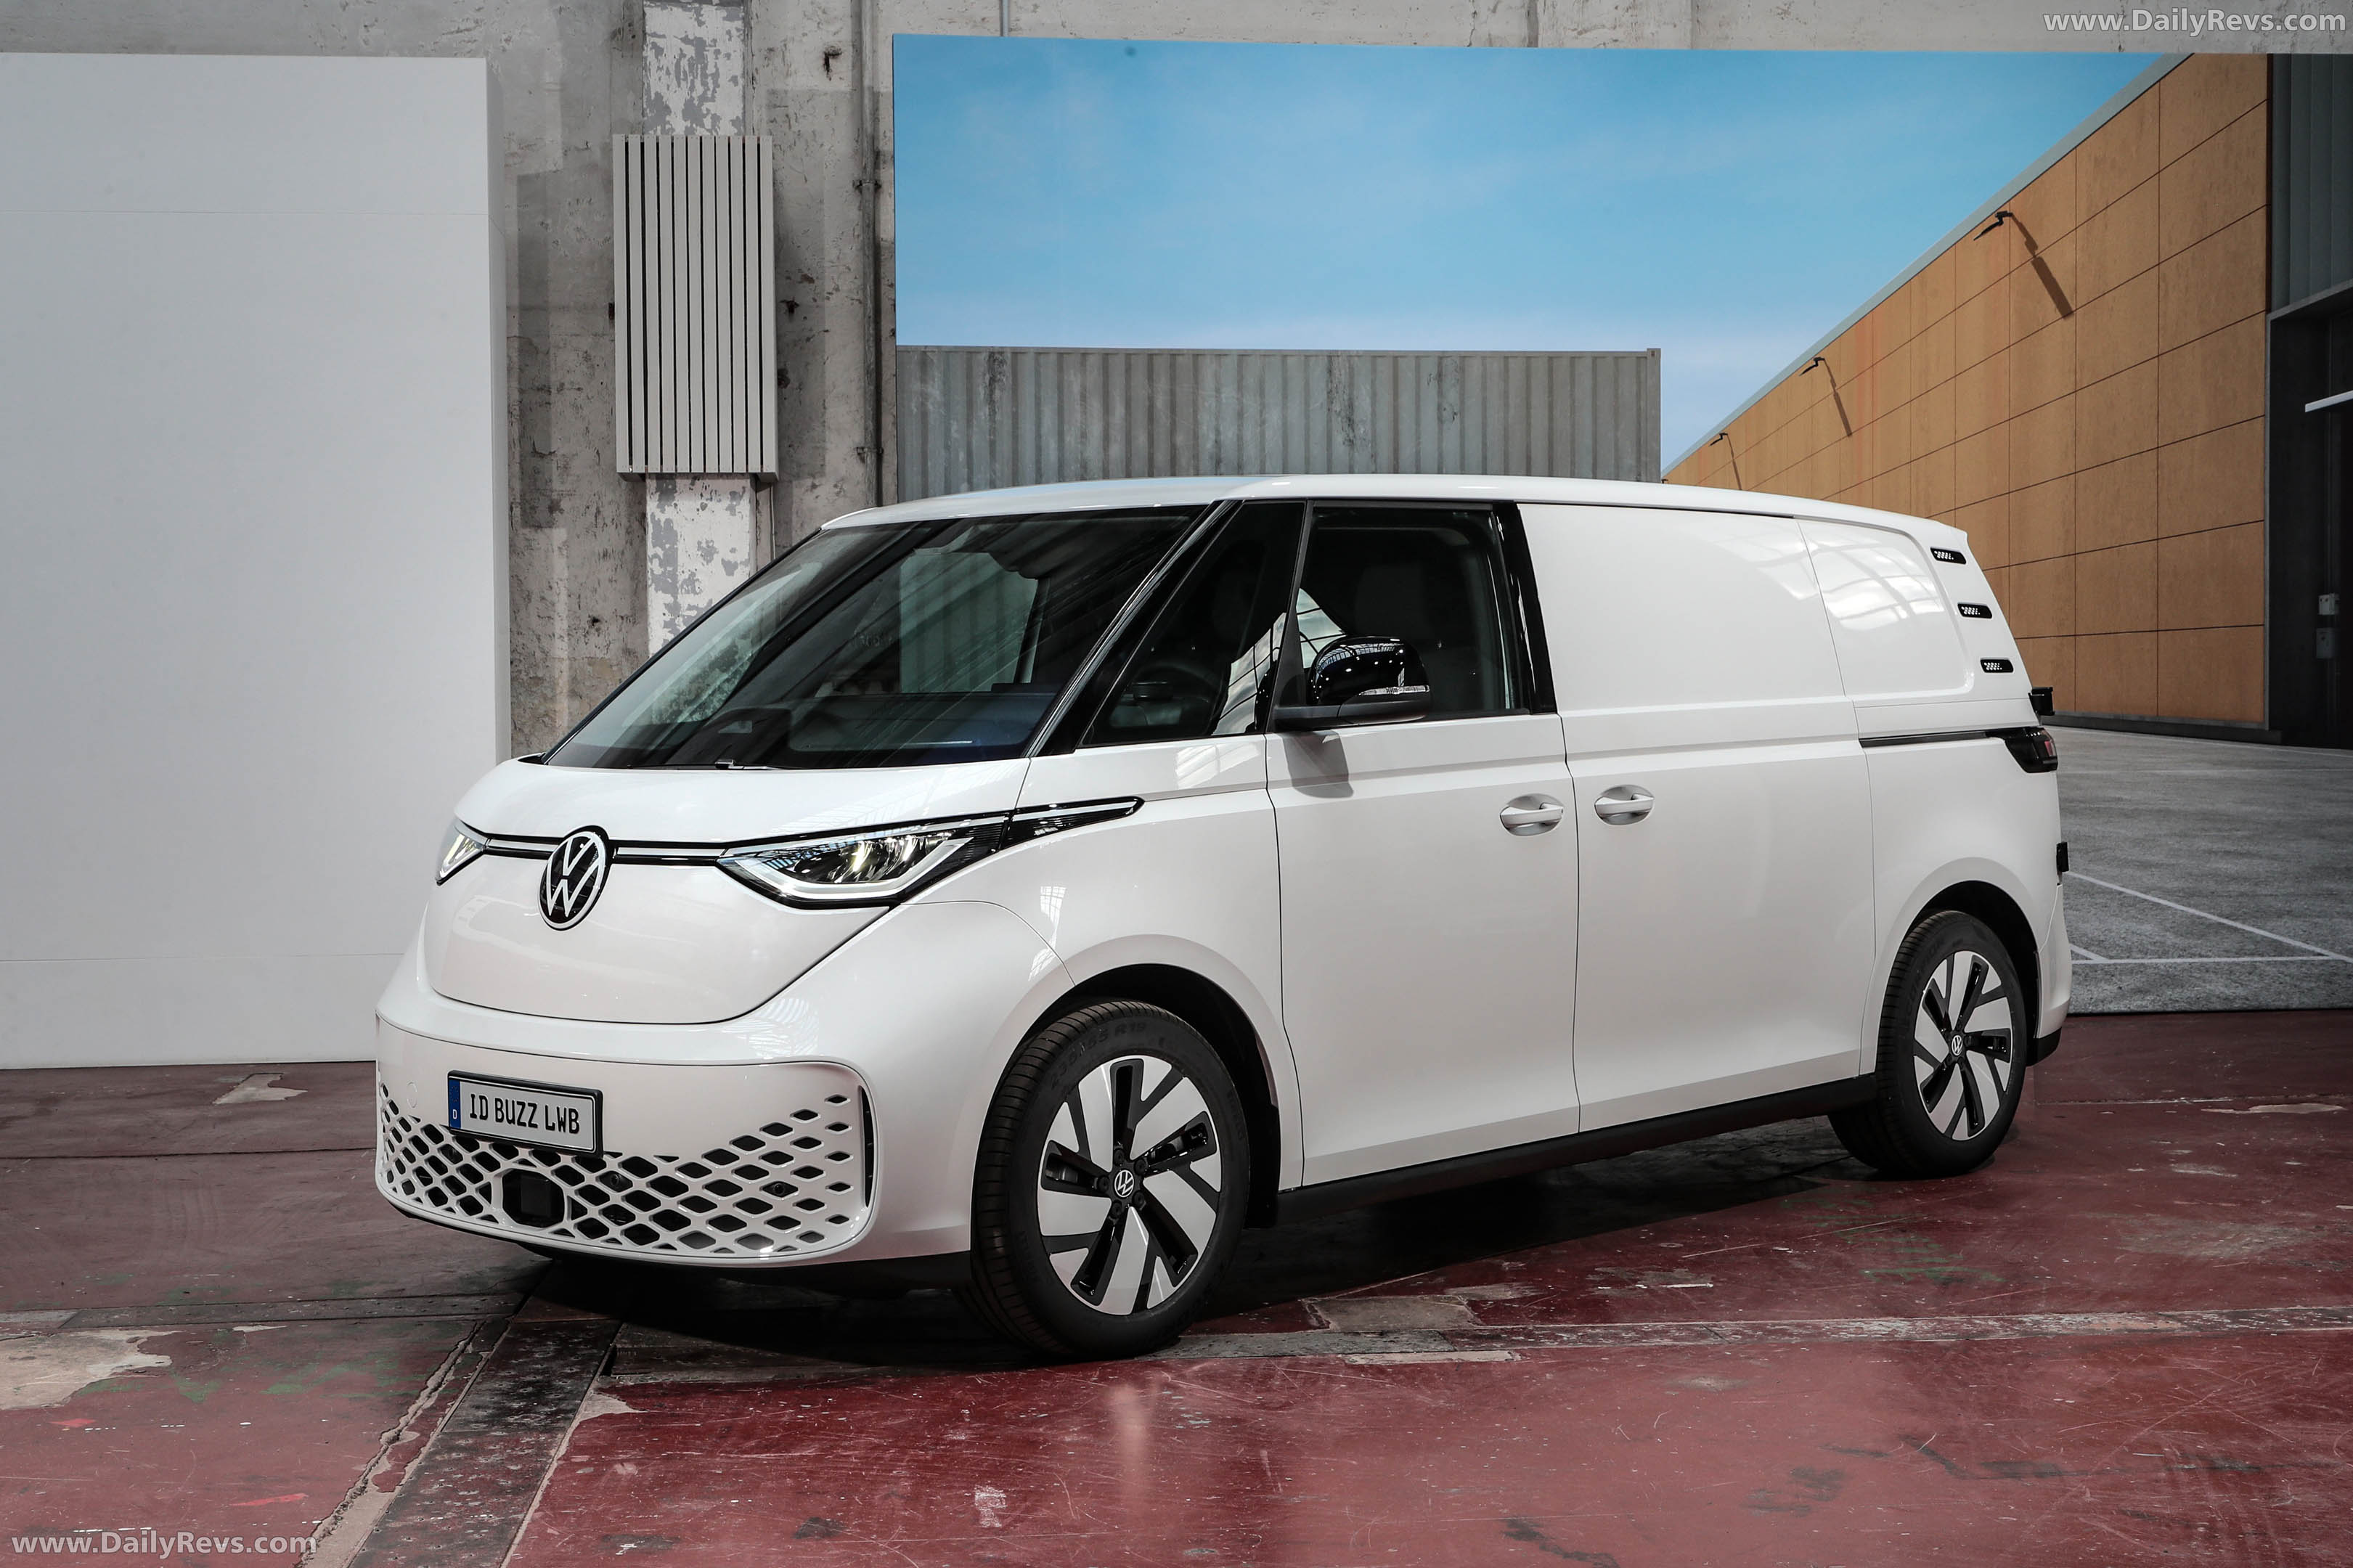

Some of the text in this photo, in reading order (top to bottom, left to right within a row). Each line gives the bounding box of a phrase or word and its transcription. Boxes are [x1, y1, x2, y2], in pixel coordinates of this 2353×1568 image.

[544, 832, 603, 920] VW
[452, 1108, 457, 1120] D
[470, 1093, 580, 1134] ID BUZZ LWB
[1116, 1170, 1134, 1196] VW
